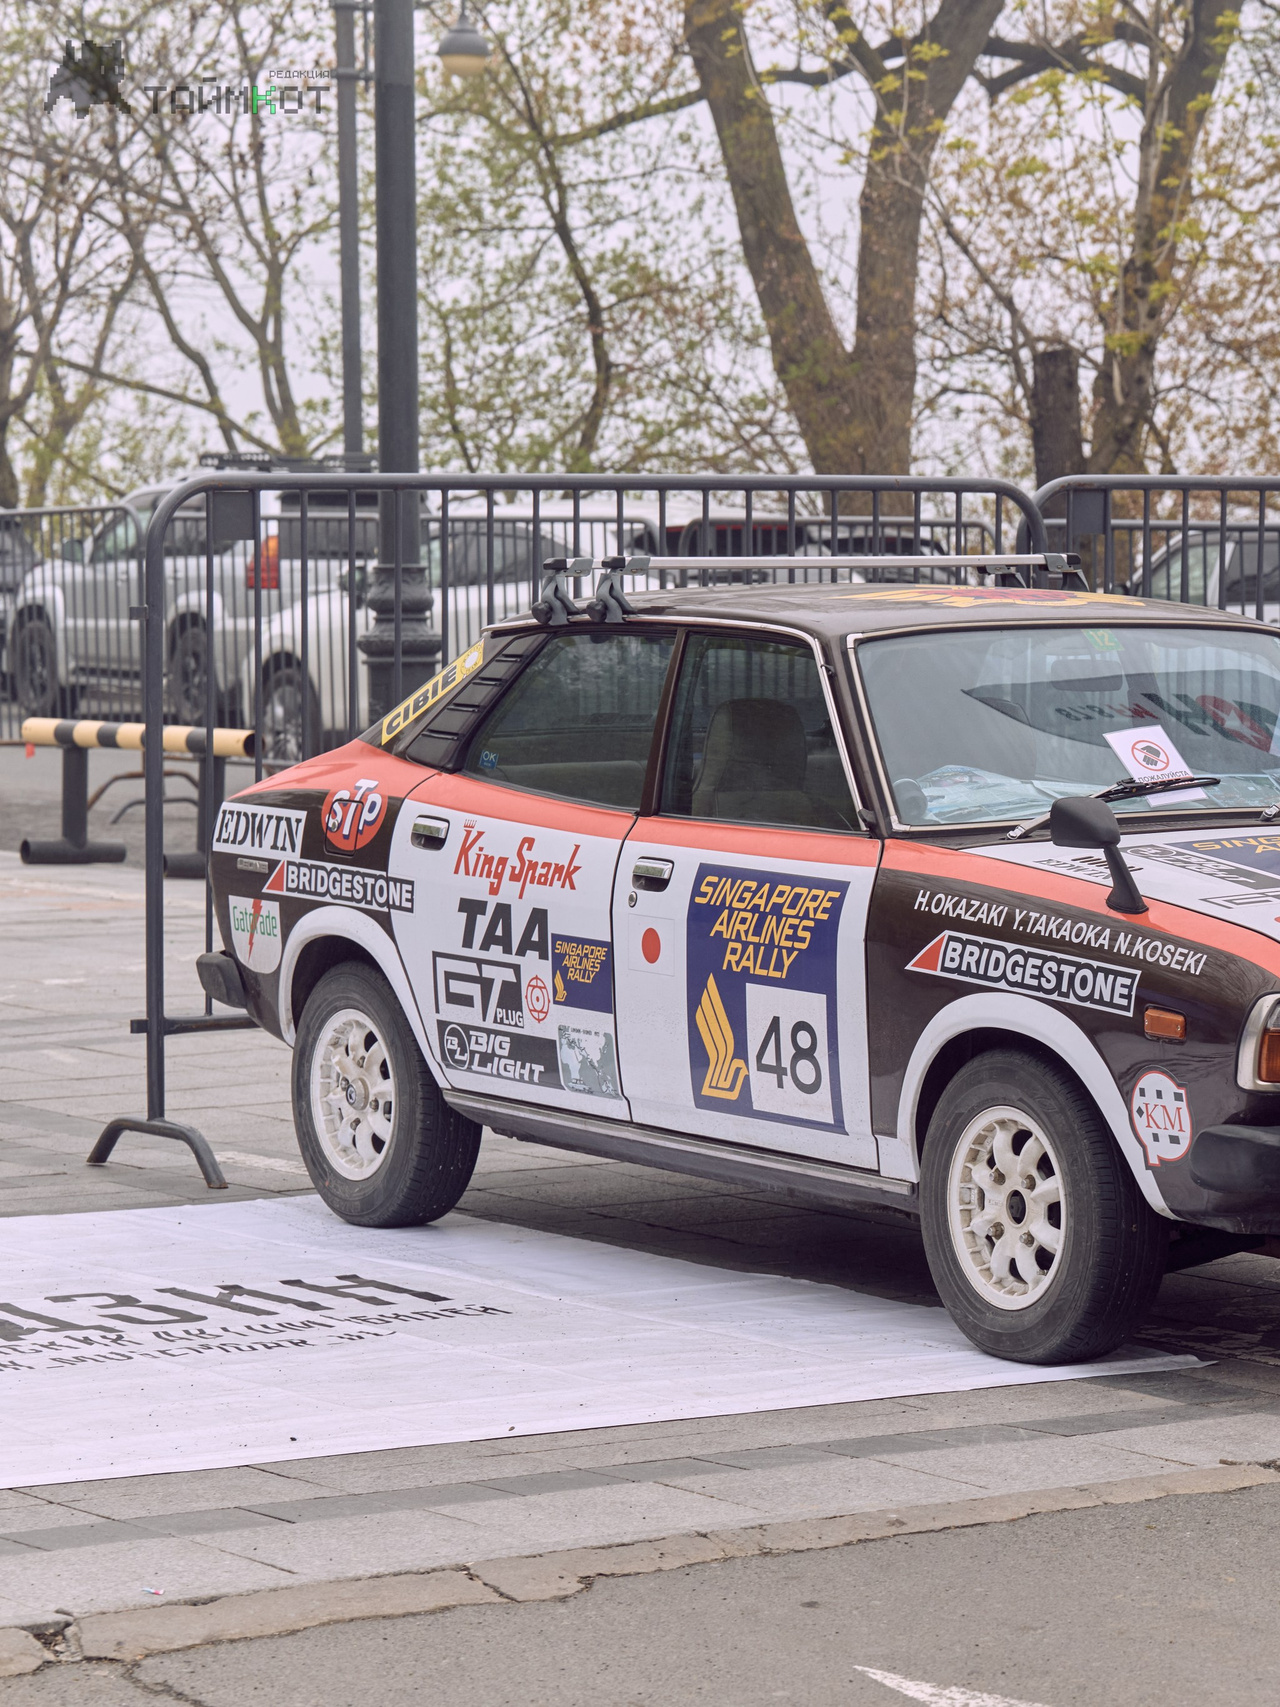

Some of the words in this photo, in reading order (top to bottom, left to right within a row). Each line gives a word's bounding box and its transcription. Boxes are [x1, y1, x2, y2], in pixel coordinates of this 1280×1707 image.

[483, 751, 497, 762] OK
[325, 778, 382, 839] STP
[215, 809, 303, 853] EDWIN
[453, 828, 509, 896] King
[508, 836, 582, 900] Spark
[287, 865, 413, 908] BRIDGESTONE
[695, 875, 841, 920] SINGAPORE
[233, 905, 278, 938] Gatorade
[458, 897, 549, 961] TAA
[710, 909, 815, 949] AIRLINES
[913, 889, 1008, 928] H.OKAZAKI
[1012, 908, 1111, 950] Y.TAKAOKA
[1113, 931, 1208, 976] N.KOSEKI
[554, 941, 608, 960] SINGAPORE
[562, 955, 601, 972] AIRLINES
[722, 942, 799, 979] RALLY
[567, 968, 596, 983] RALLY
[943, 941, 1133, 1006] BRIDGESTONE
[496, 1008, 524, 1028] PLUG
[469, 1030, 511, 1057] BIG
[756, 1015, 822, 1095] 48
[472, 1054, 545, 1083] LIGHT
[1143, 1101, 1186, 1133] KM
